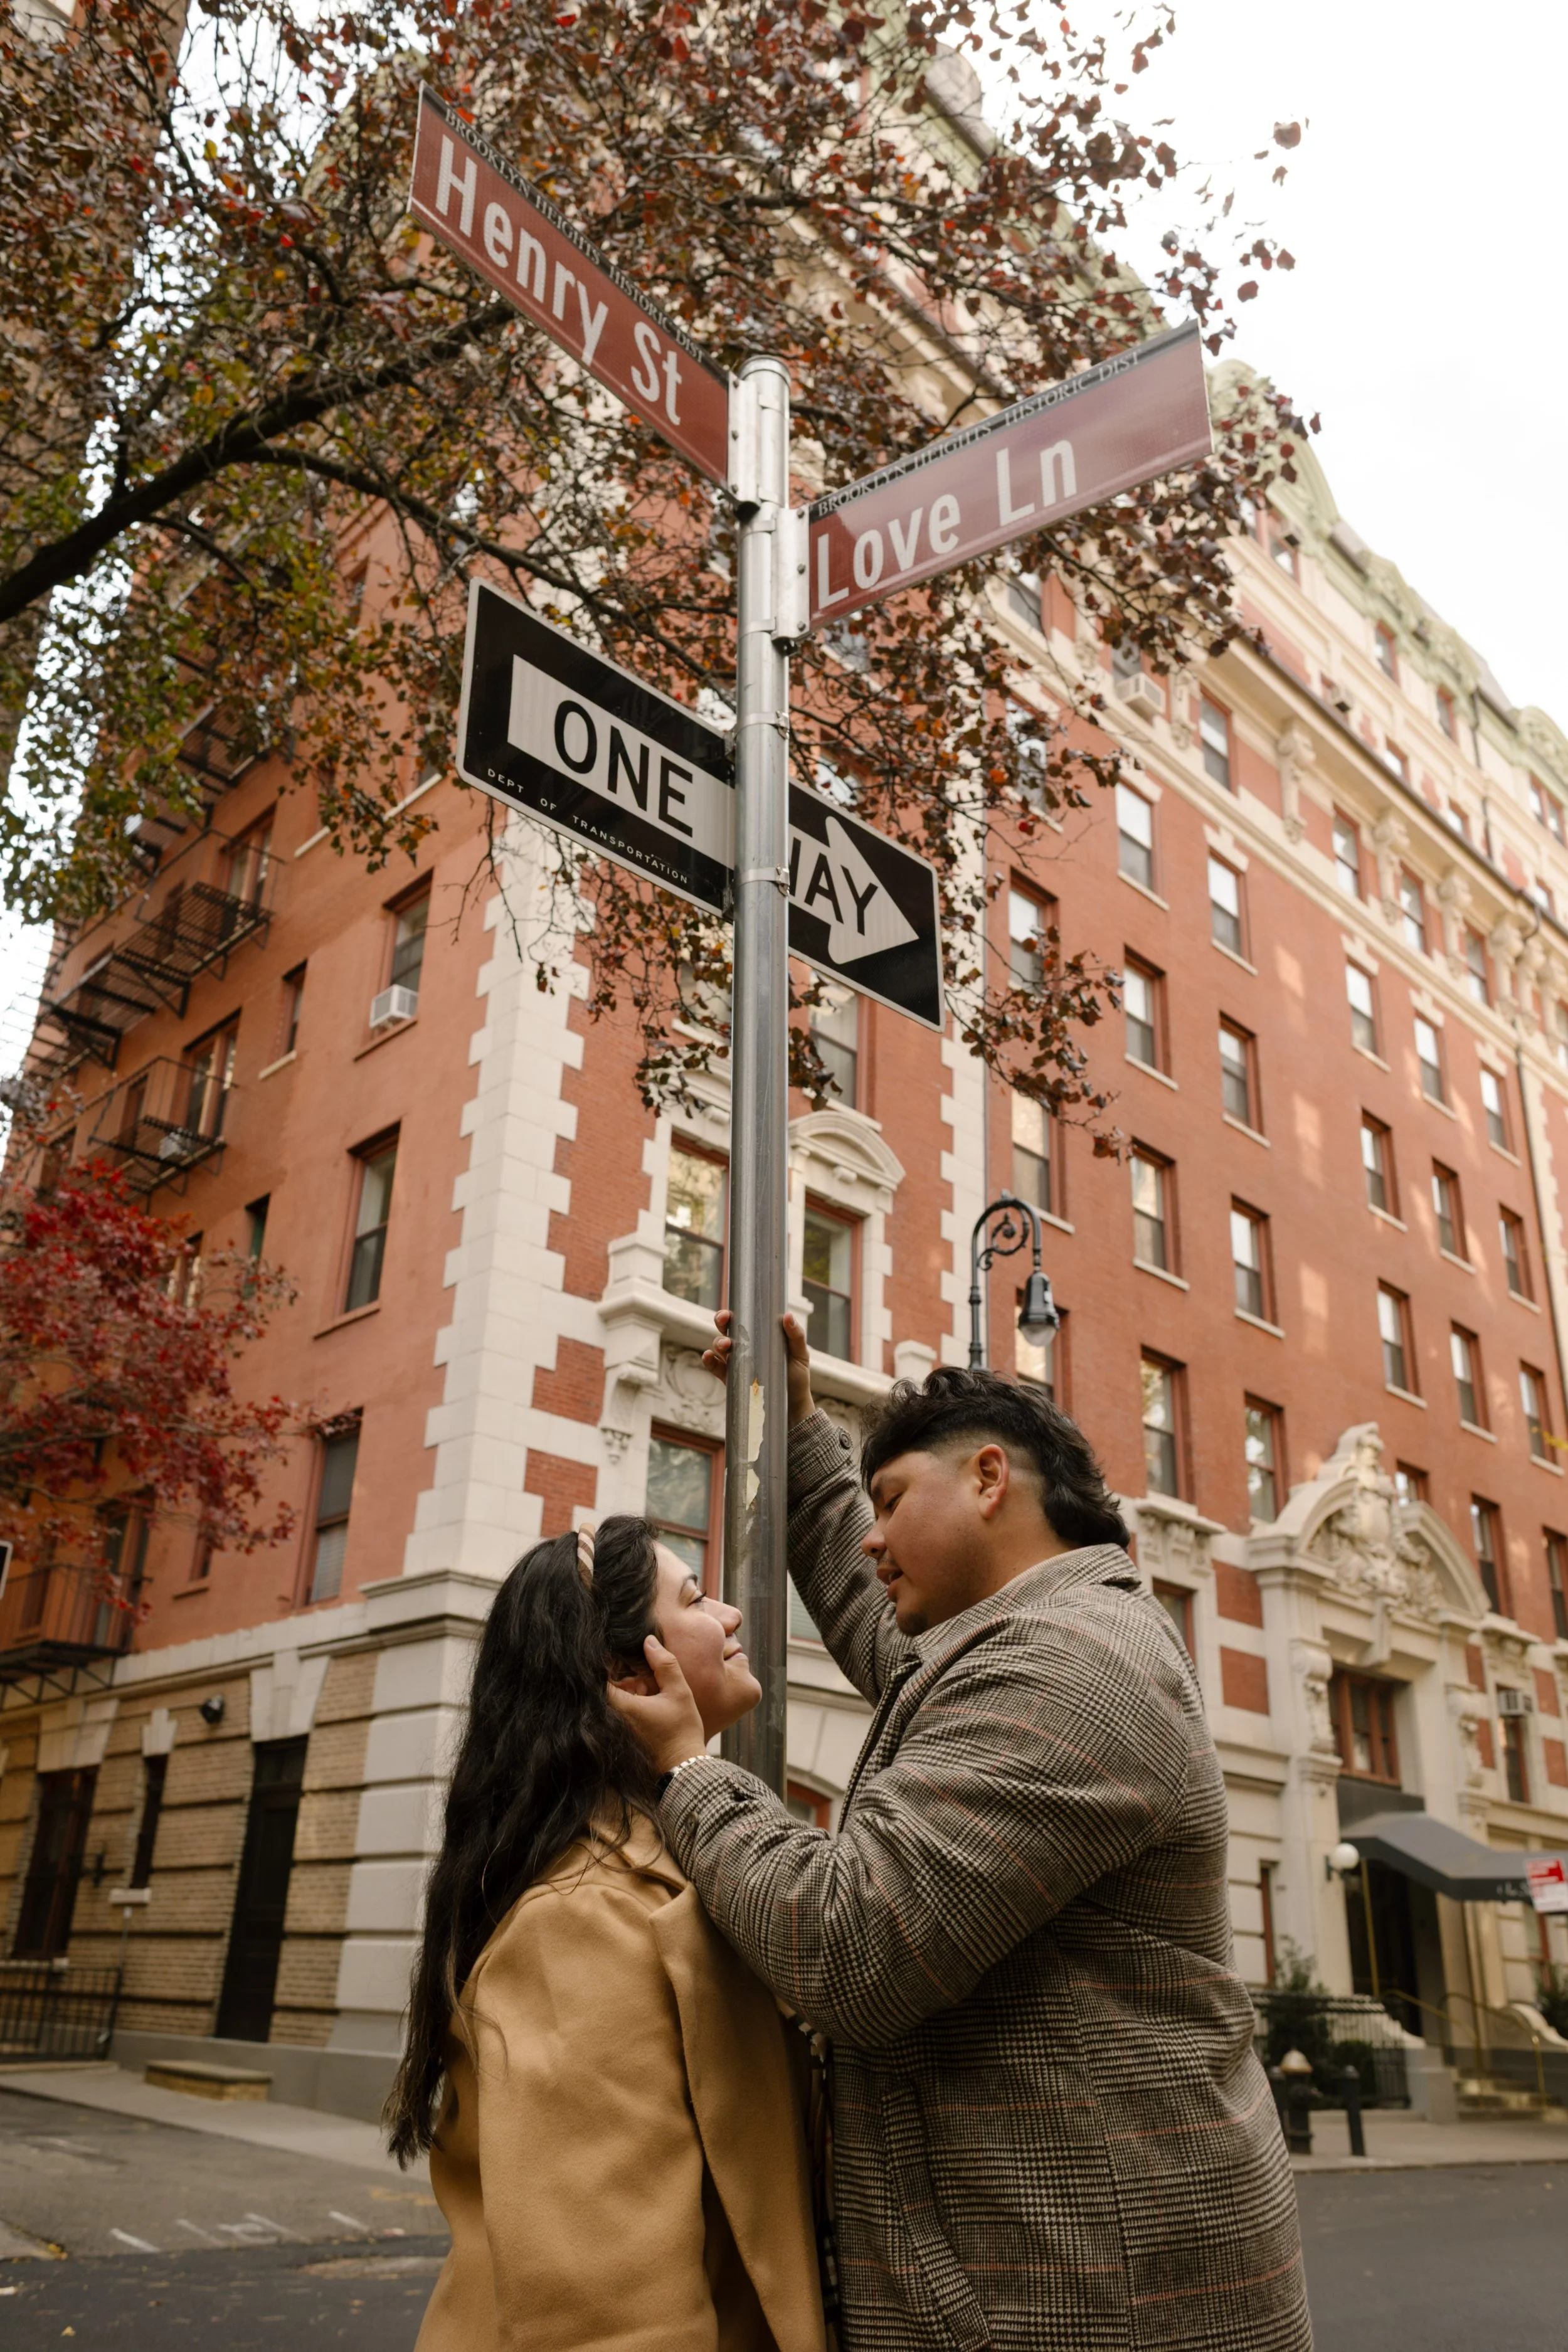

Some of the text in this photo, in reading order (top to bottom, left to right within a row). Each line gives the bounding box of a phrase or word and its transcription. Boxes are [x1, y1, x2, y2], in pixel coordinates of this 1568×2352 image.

[435, 134, 682, 425] Henry St
[445, 107, 703, 363] BROOKLYN HEIGHTS HISTORIC DIST
[818, 349, 1142, 517] BROOKLYN HEIGHTS HISTORIC DIST
[817, 439, 1078, 610] Love Ln
[487, 768, 689, 885] DEPT OF TRANSPORTATION
[554, 699, 694, 839] ONE
